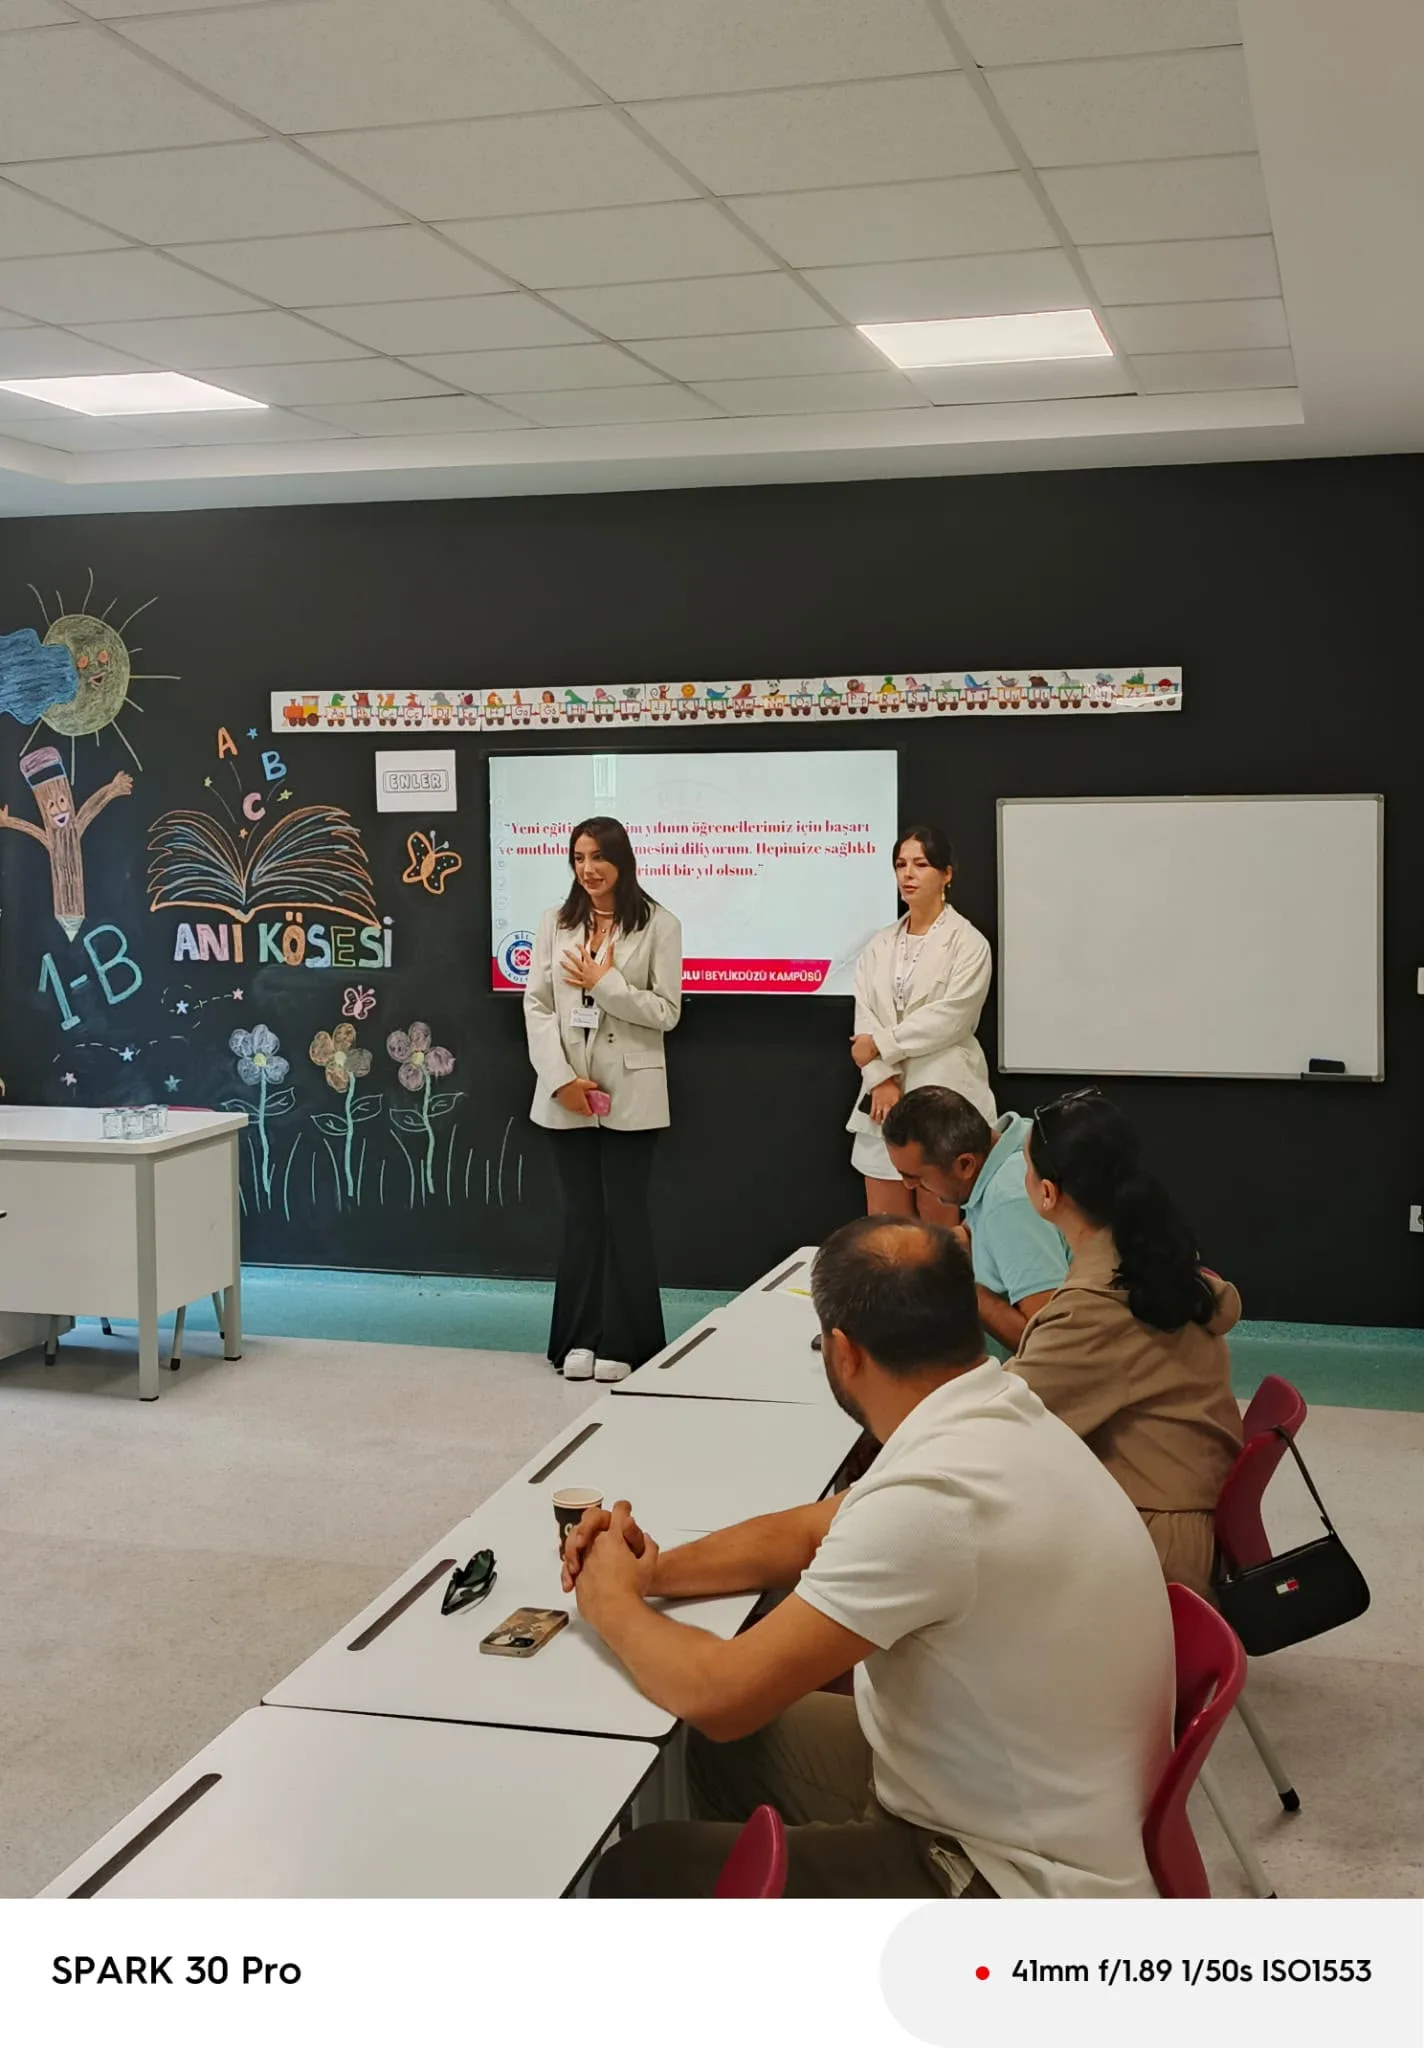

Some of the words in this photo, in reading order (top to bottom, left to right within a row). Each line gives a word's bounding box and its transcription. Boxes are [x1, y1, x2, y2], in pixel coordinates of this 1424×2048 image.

[216, 727, 238, 760] A
[261, 751, 287, 781] B
[389, 773, 442, 790] ENLER
[242, 793, 266, 821] C
[543, 821, 575, 837] eğiti
[796, 819, 822, 837] için
[825, 819, 870, 836] başarı
[516, 842, 569, 856] mutlulu
[634, 842, 679, 856] mesini
[681, 842, 753, 858] diliyorum.
[756, 841, 822, 858] Hepimize
[674, 863, 694, 877] bir
[696, 863, 713, 879] yıl
[173, 923, 244, 964] ANI
[258, 911, 395, 968] KÖSESİ
[37, 922, 143, 1032] 1-B
[704, 968, 768, 982] BEYLİKDÜZÜ
[769, 969, 823, 983] KAMPÜSÜ
